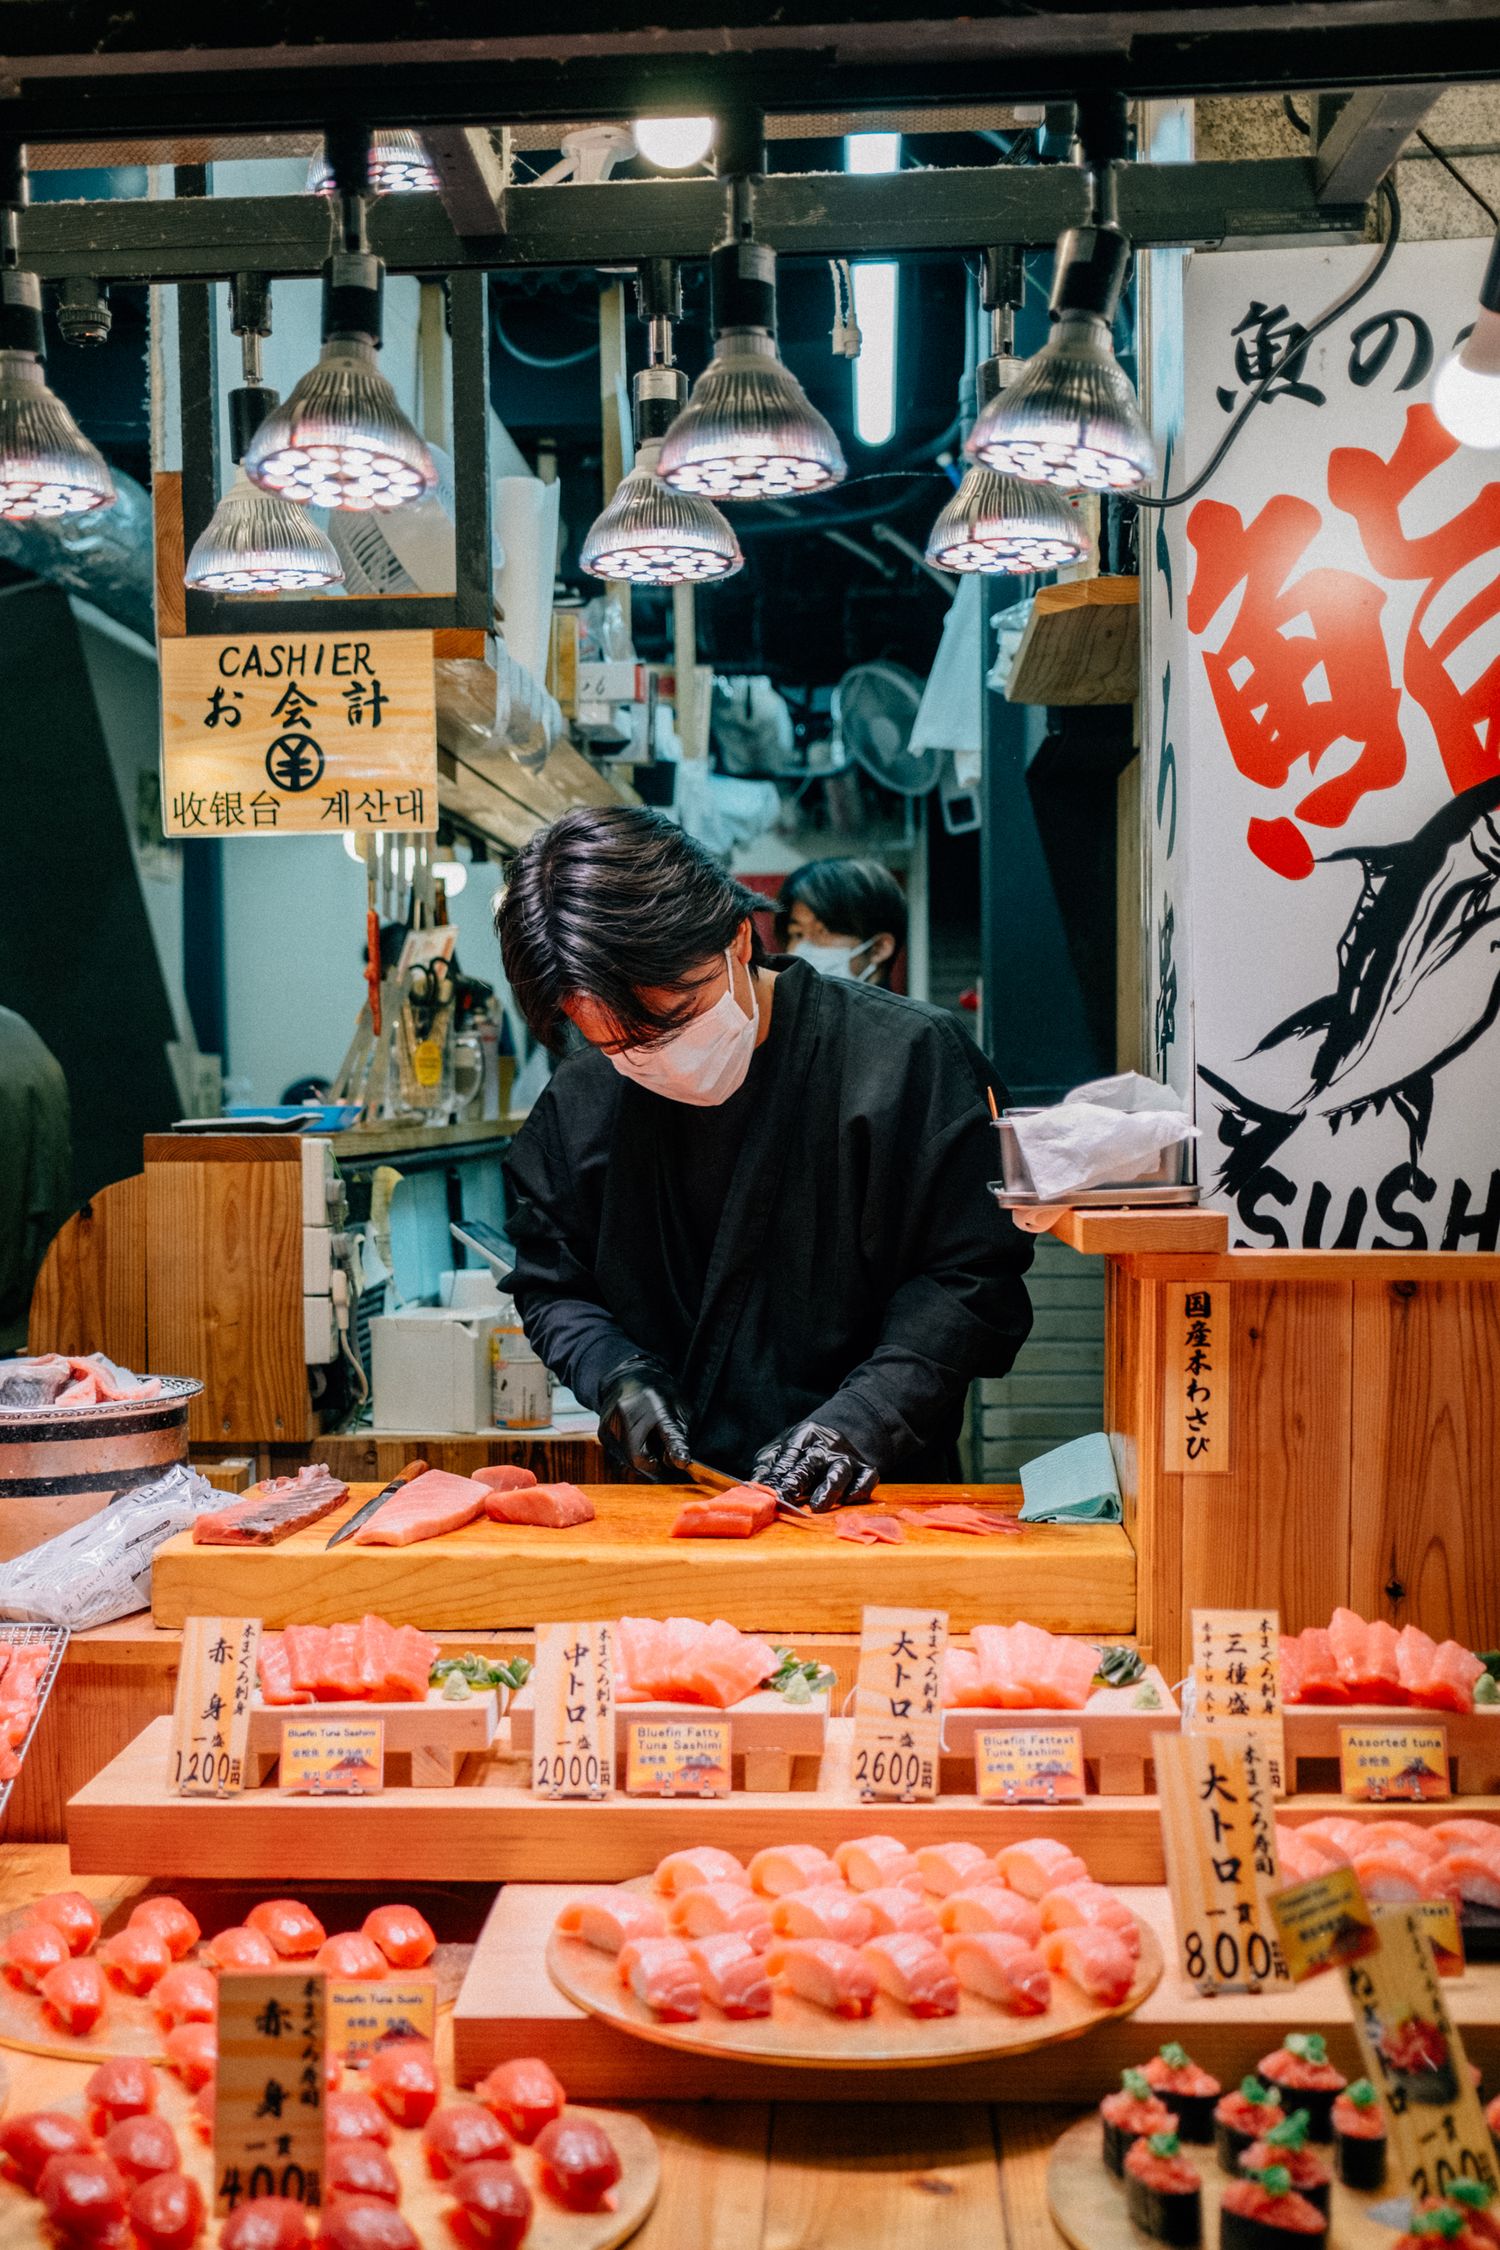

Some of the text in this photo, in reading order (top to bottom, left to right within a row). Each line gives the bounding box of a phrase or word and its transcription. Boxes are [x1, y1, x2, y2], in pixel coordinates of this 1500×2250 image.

[1216, 301, 1477, 413] 魚の
[218, 643, 376, 678] CASHIER
[204, 679, 390, 729] お会計
[173, 790, 280, 829] 收银台
[320, 788, 425, 825] 계산대
[1185, 1291, 1213, 1461] 国産本わさび
[201, 1637, 234, 1721] 赤身
[564, 1643, 590, 1723] 中トロ
[890, 1630, 918, 1718] 大トロ
[1225, 1632, 1250, 1716] 三種盛
[637, 1727, 720, 1738] Bluefin Fatty
[639, 1740, 722, 1750] Tuna Sashimi
[984, 1735, 1025, 1746] Bluefin
[1348, 1737, 1442, 1749] Assorted tuna
[175, 1751, 230, 1784] 1200
[538, 1755, 598, 1786] 2000
[856, 1750, 919, 1787] 2600
[985, 1747, 1065, 1757] Tuna Sashimi
[1200, 1763, 1241, 1884] 大トロ
[1185, 1931, 1271, 1979] 800
